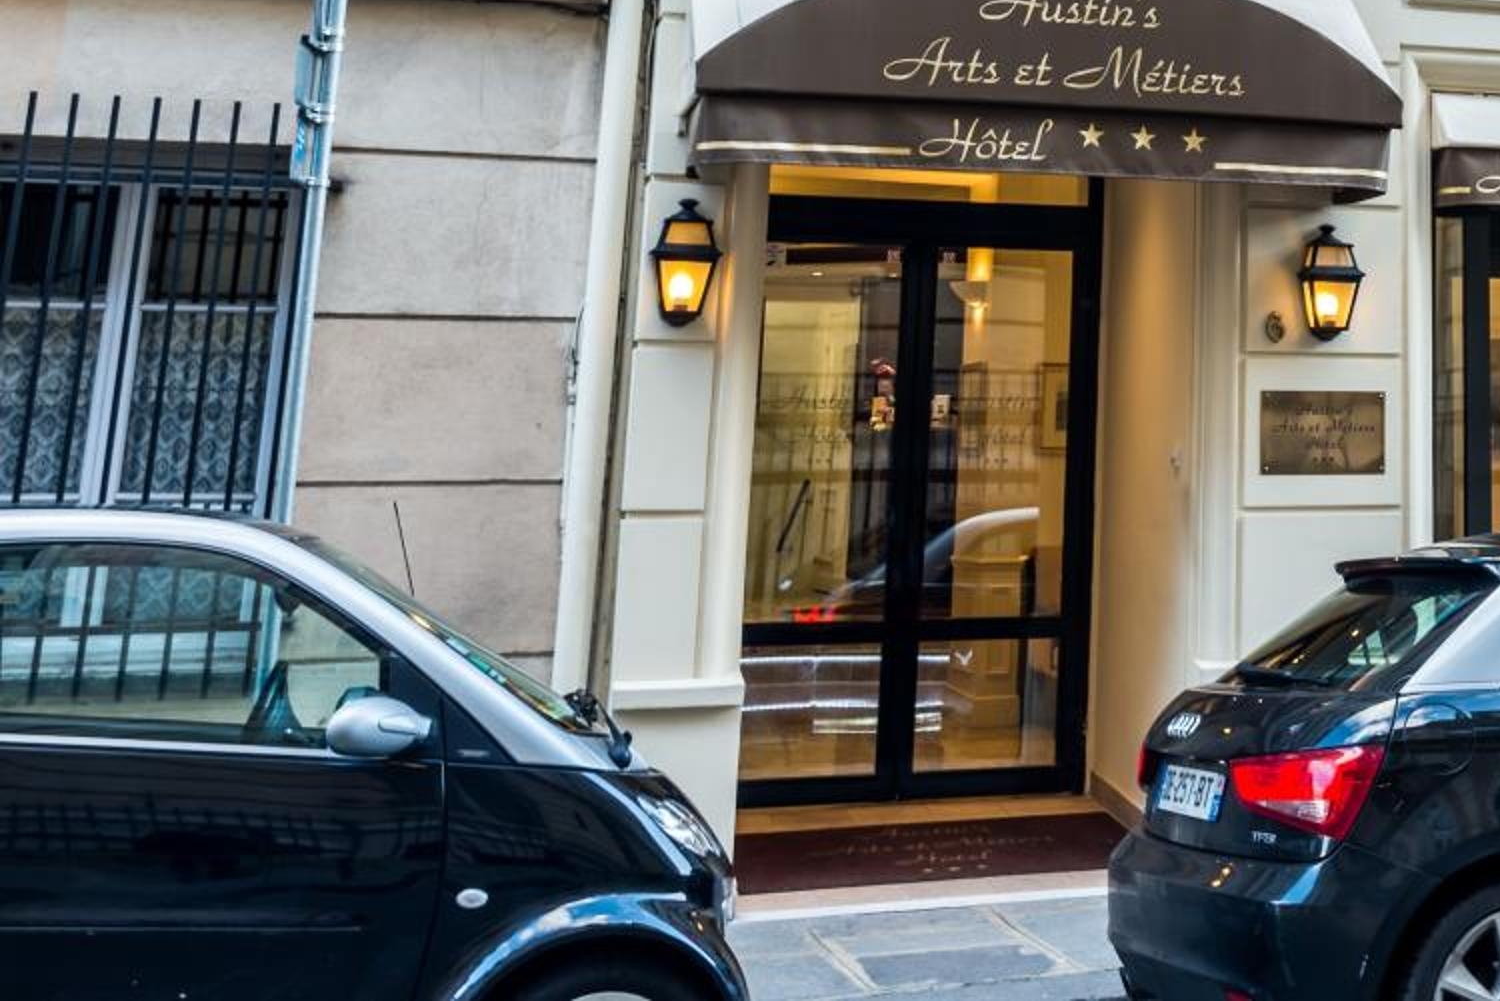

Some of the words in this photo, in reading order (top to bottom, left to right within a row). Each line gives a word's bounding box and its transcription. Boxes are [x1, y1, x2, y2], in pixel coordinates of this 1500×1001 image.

[882, 36, 1000, 86] Arts
[1014, 55, 1052, 87] et
[1063, 46, 1246, 99] Métiers
[918, 117, 1055, 164] Hôtel
